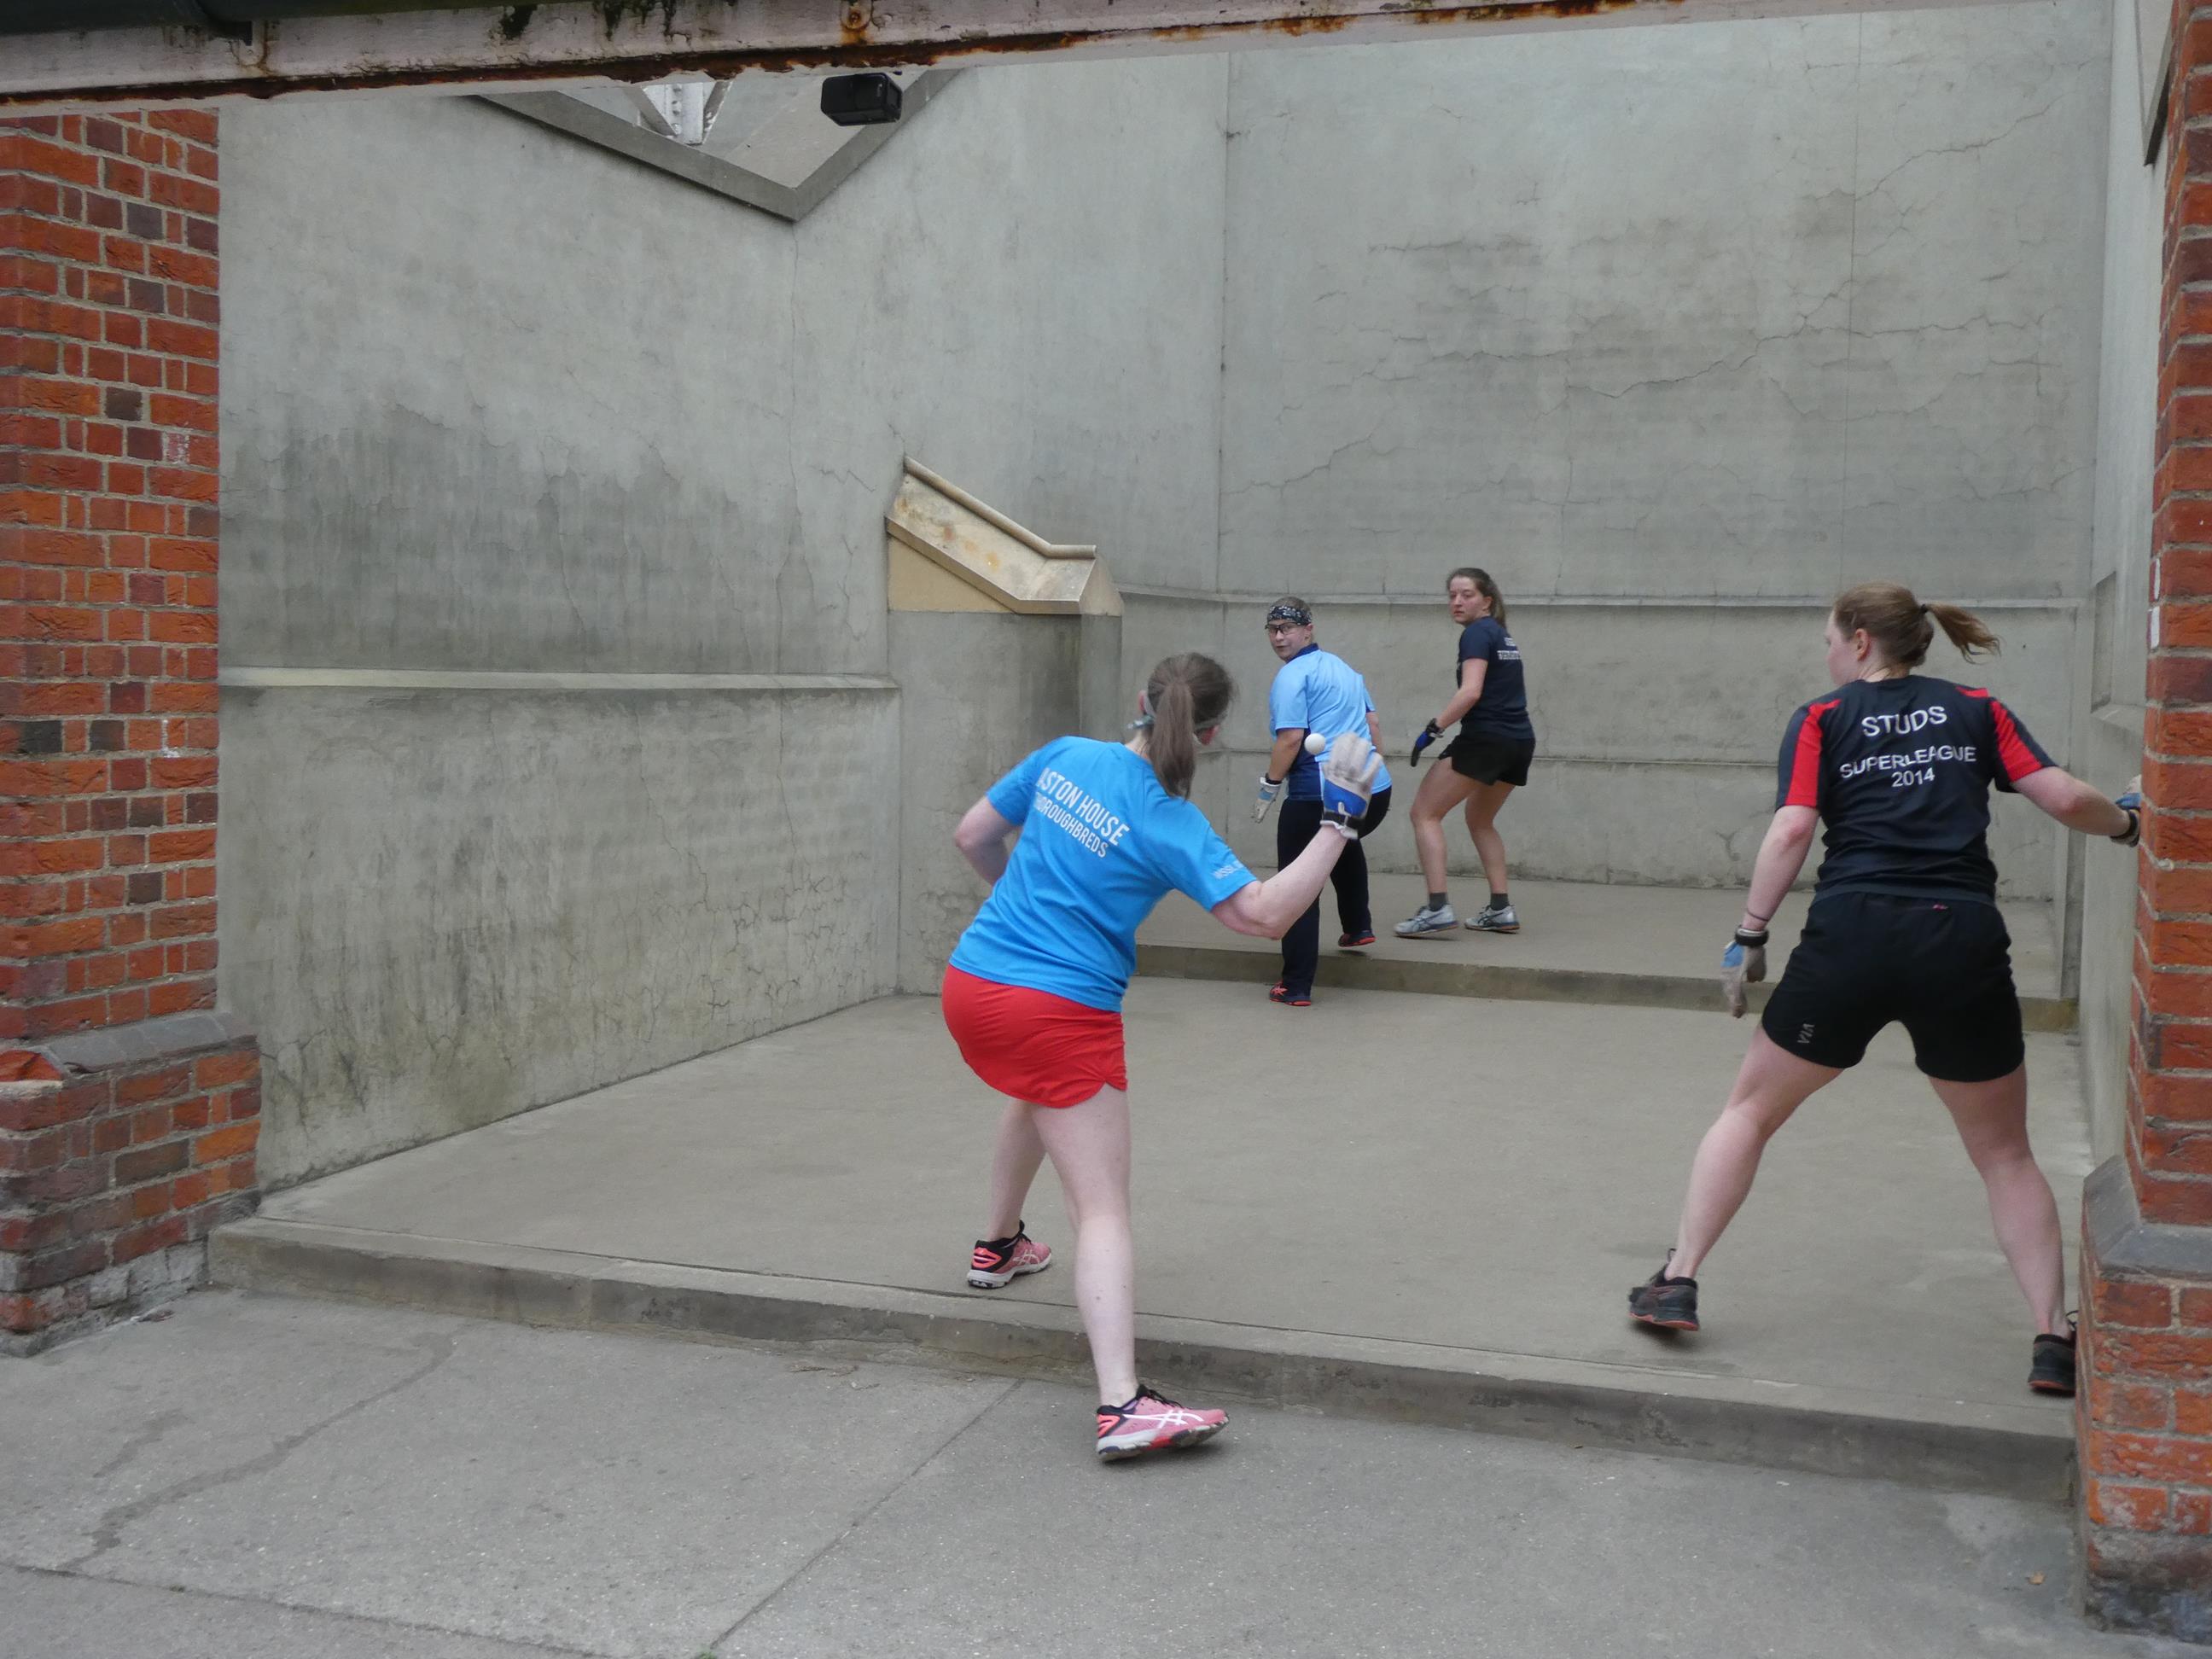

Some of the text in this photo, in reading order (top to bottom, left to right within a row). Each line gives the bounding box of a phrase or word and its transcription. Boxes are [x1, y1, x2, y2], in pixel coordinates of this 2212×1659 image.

[1862, 706, 1947, 737] STUDS
[1839, 744, 1976, 779] SUPERLEAGUE
[1891, 766, 1936, 788] 2014
[1075, 795, 1130, 847] HOUSE
